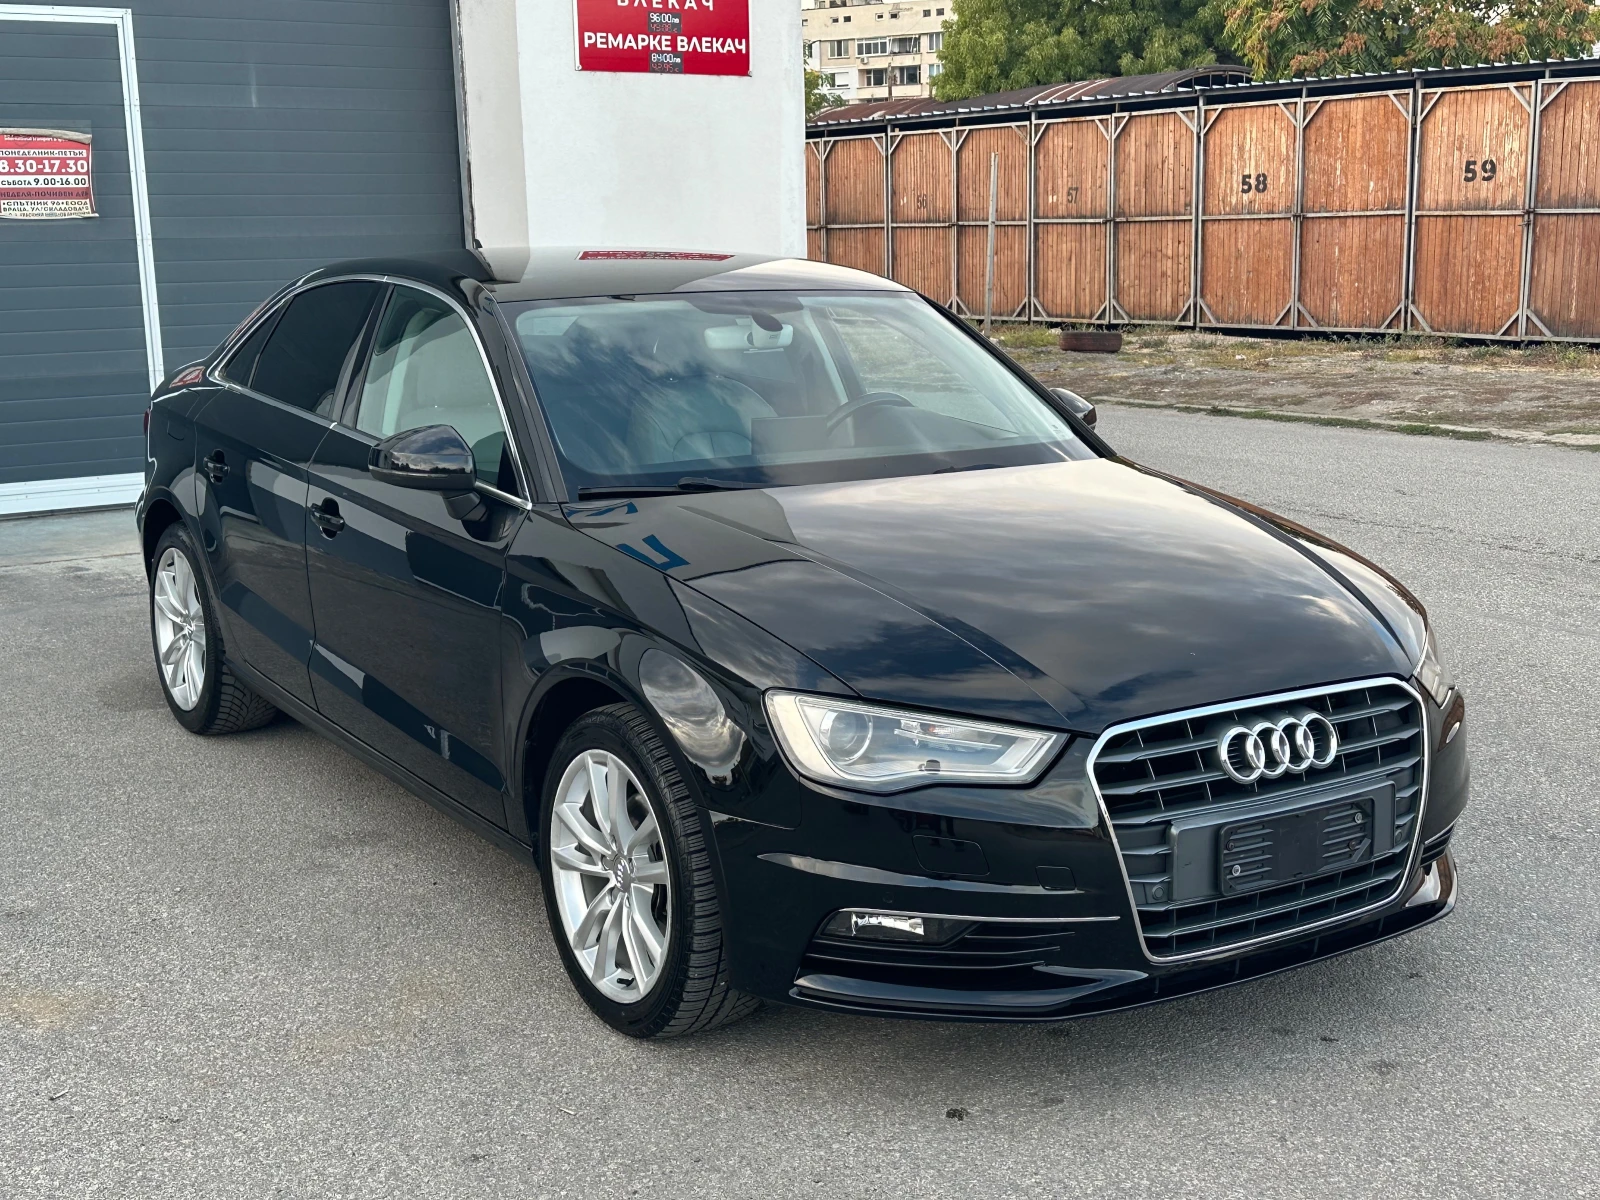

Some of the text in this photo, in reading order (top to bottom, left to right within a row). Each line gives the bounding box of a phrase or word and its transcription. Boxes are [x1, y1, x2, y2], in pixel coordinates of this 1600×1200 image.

[583, 31, 746, 54] РЕМАРКЕ ВЛЕКАЧ
[0, 159, 88, 173] 8.30-17.30
[1463, 159, 1497, 183] 59
[33, 177, 87, 186] 9.00-16.00
[1241, 172, 1268, 194] 58
[1067, 186, 1079, 204] 57
